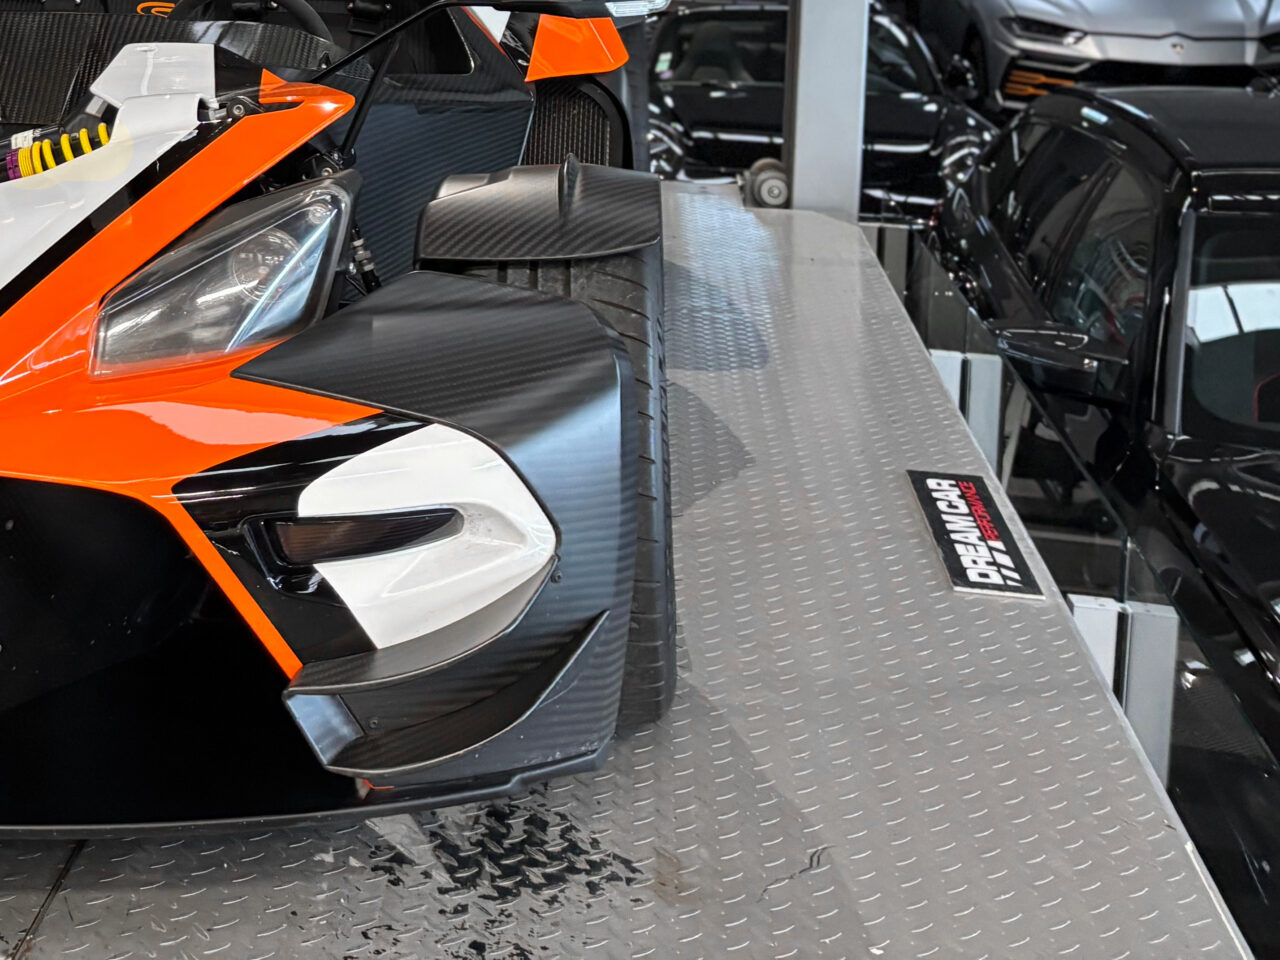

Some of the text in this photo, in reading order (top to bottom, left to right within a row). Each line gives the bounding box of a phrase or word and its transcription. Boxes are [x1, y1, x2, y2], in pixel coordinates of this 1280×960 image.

[926, 478, 1005, 585] DREAM CAR
[958, 480, 1001, 541] PERFORMANCE
